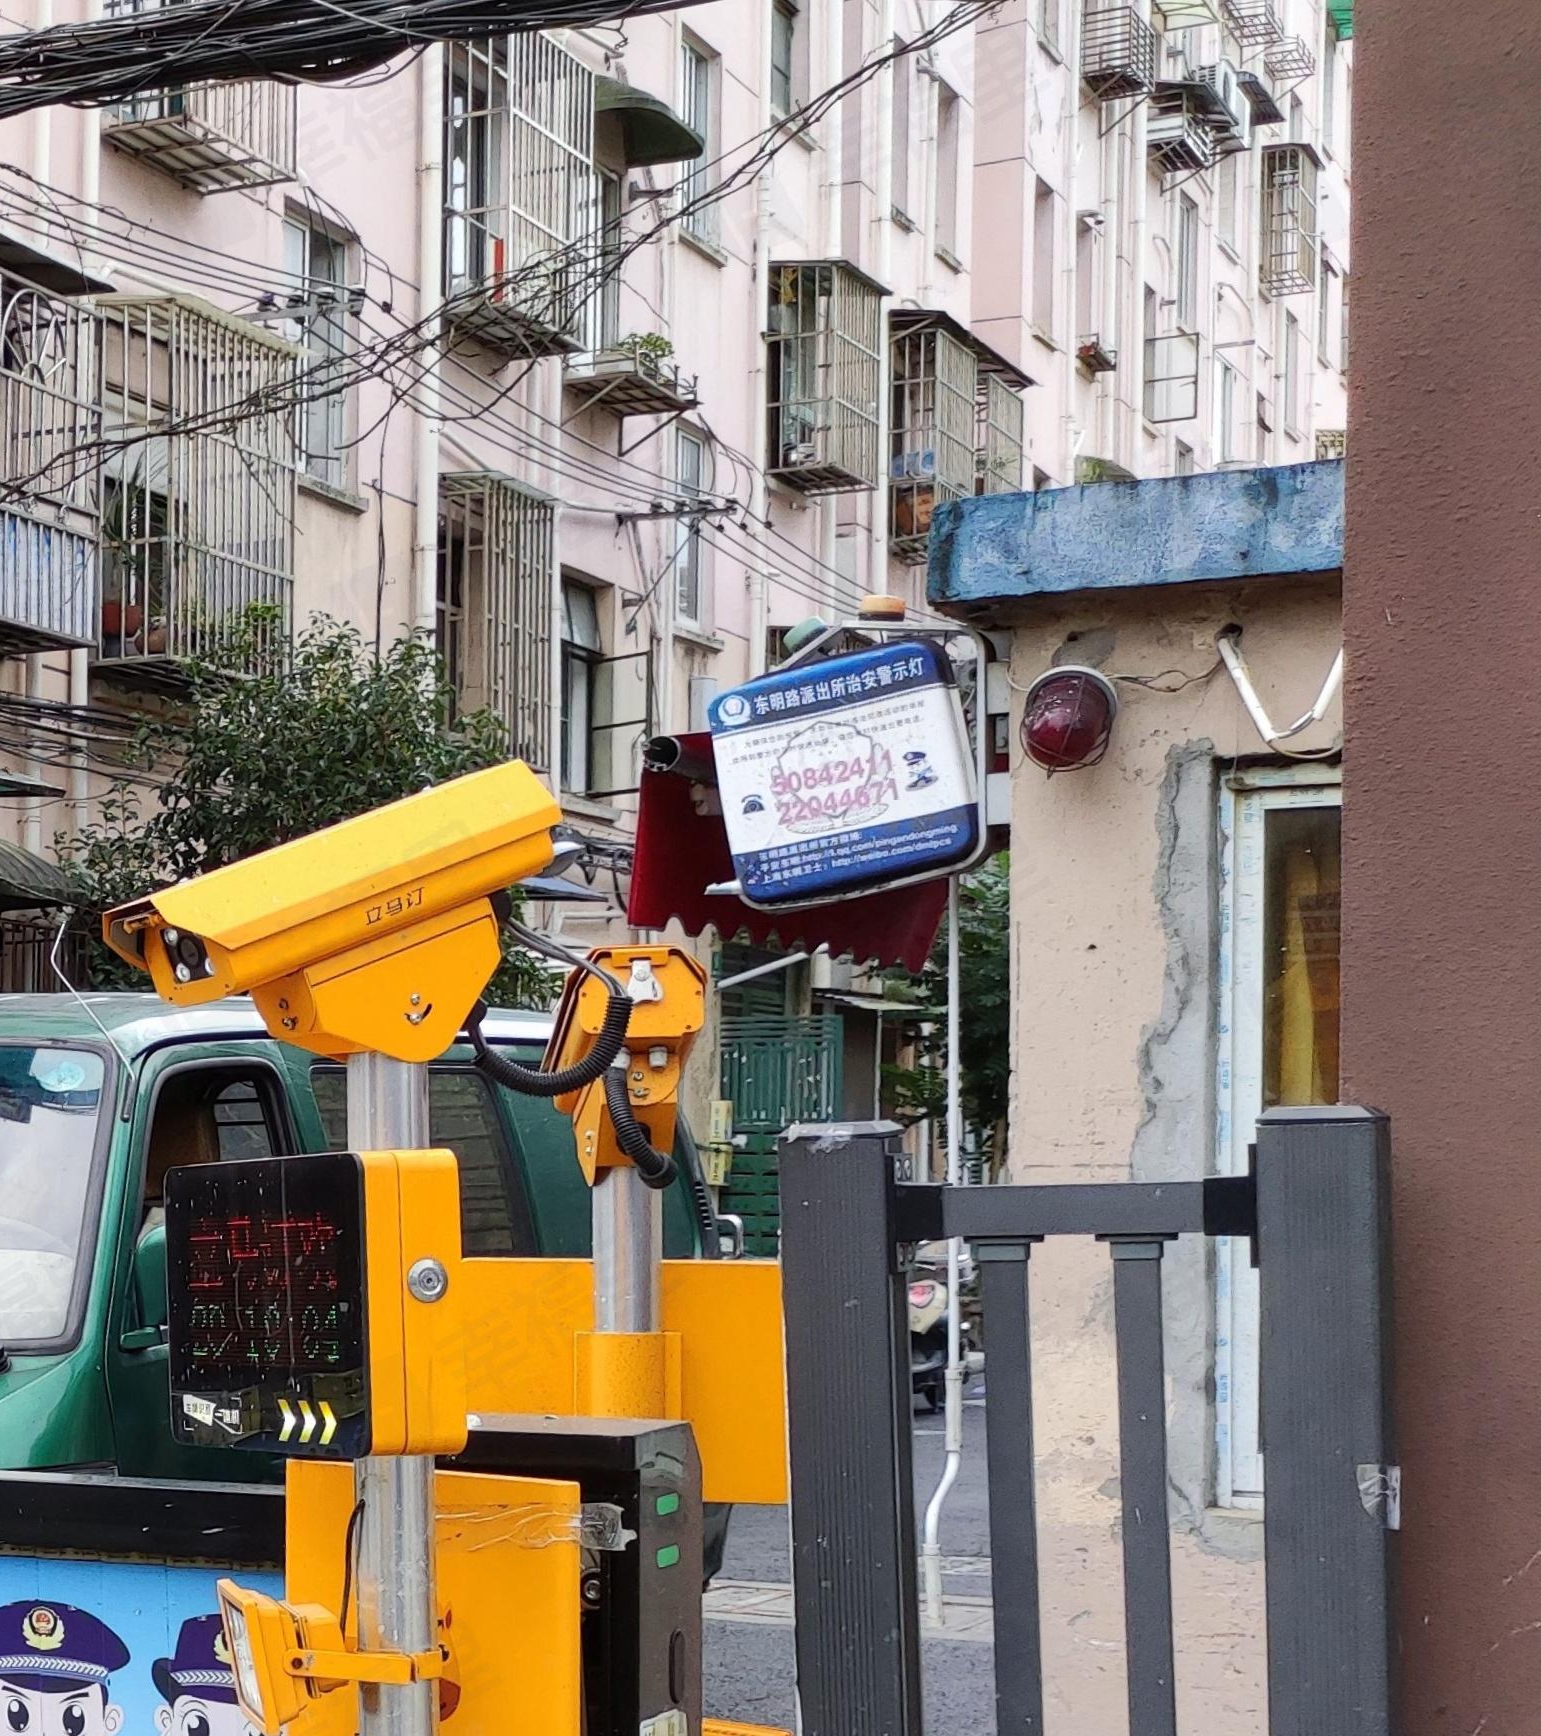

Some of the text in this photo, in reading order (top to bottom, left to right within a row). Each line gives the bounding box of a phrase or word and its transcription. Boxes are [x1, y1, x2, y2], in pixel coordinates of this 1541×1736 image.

[754, 656, 924, 715] 东明路派出所治安警示灯
[771, 749, 893, 795] 50842411
